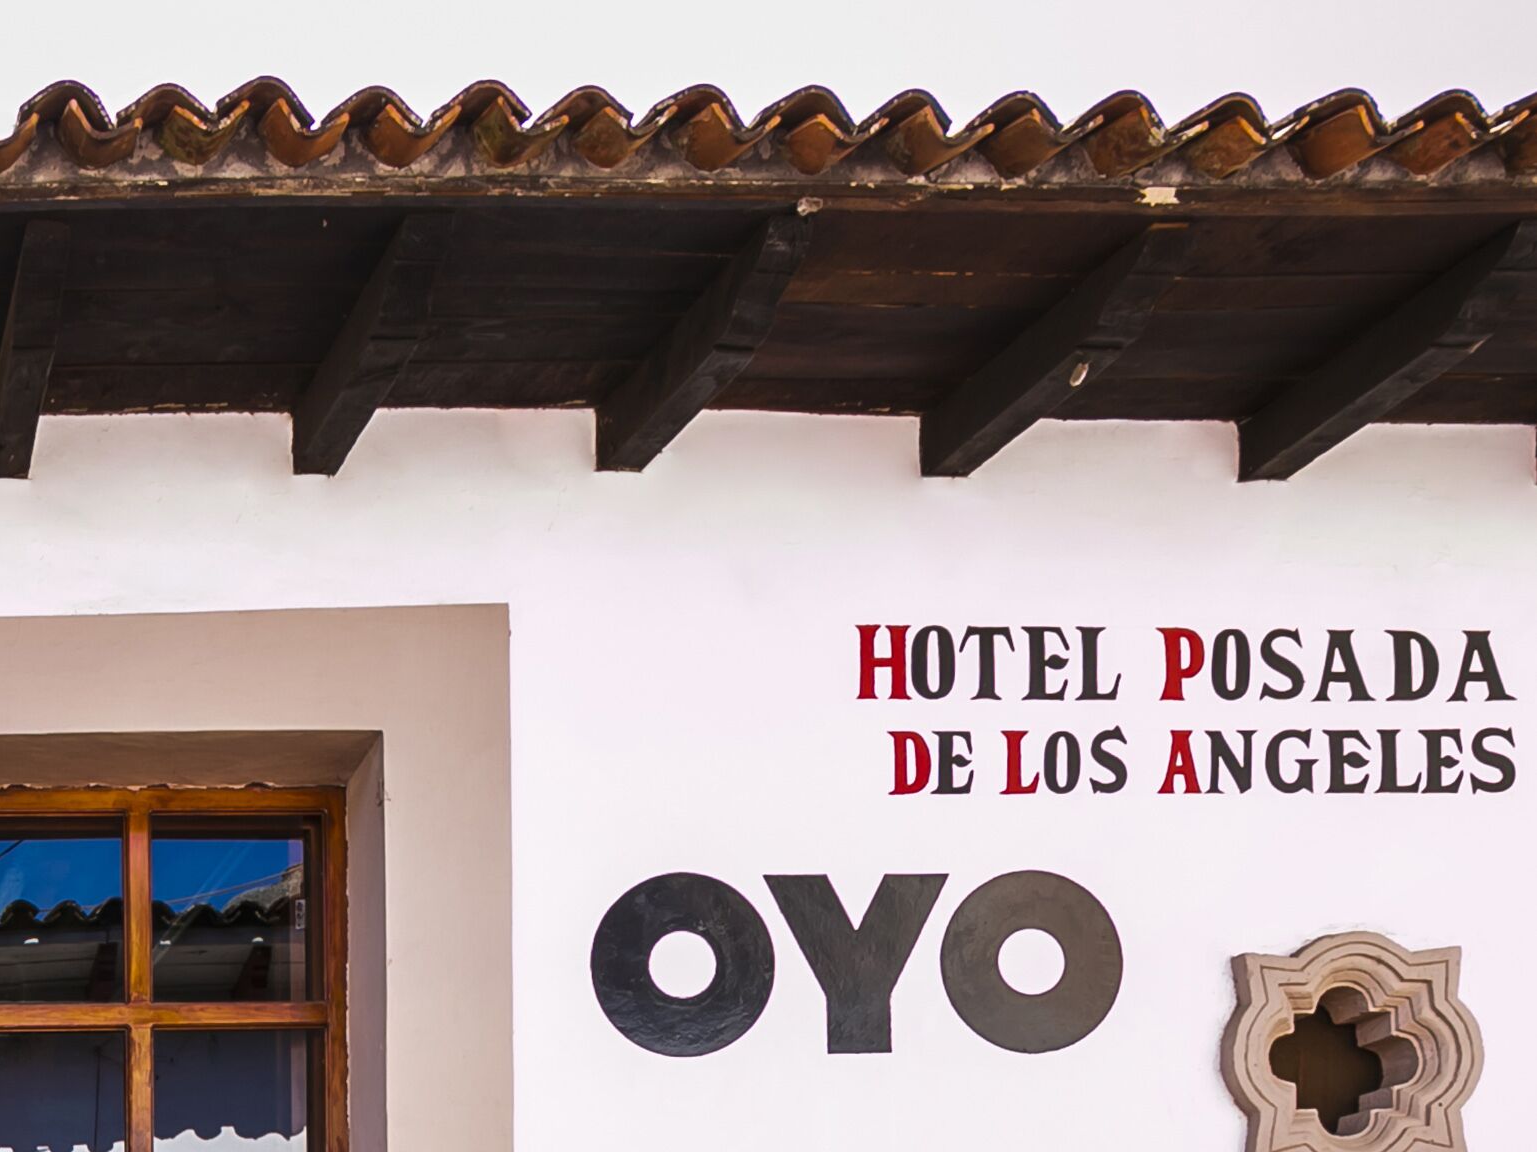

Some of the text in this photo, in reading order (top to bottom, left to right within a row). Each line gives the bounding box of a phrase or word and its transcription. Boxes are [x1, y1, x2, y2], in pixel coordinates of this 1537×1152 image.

[855, 624, 1518, 702] HOTEL POSADA
[888, 725, 1518, 795] DE LOS ANGELES
[591, 870, 1124, 1058] OYO
